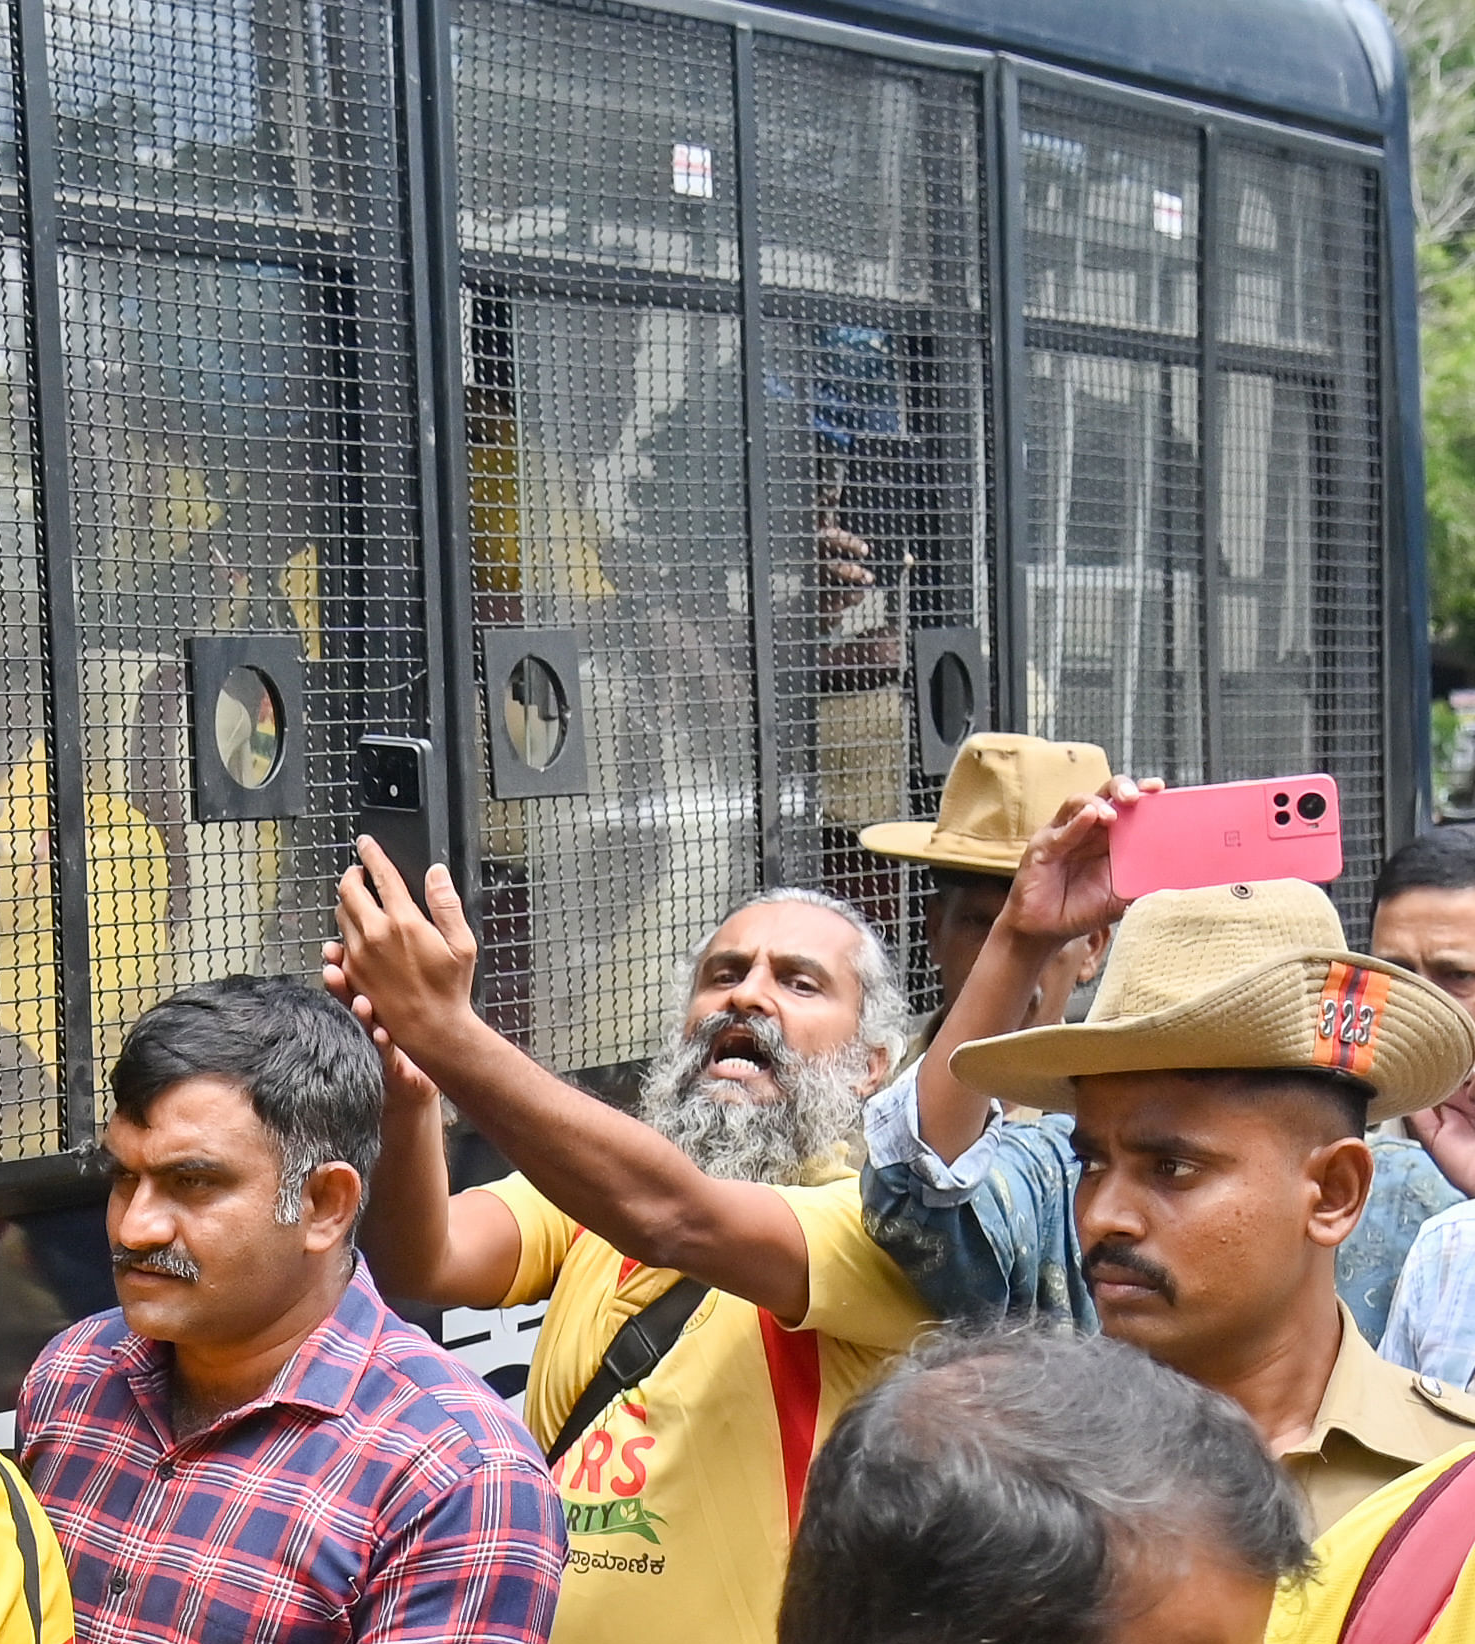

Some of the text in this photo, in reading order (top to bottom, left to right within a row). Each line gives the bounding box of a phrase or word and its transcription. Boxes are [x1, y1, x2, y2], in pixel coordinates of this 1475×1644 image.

[1318, 999, 1375, 1044] 323
[553, 1430, 656, 1497] RS
[565, 1502, 616, 1532] RTY
